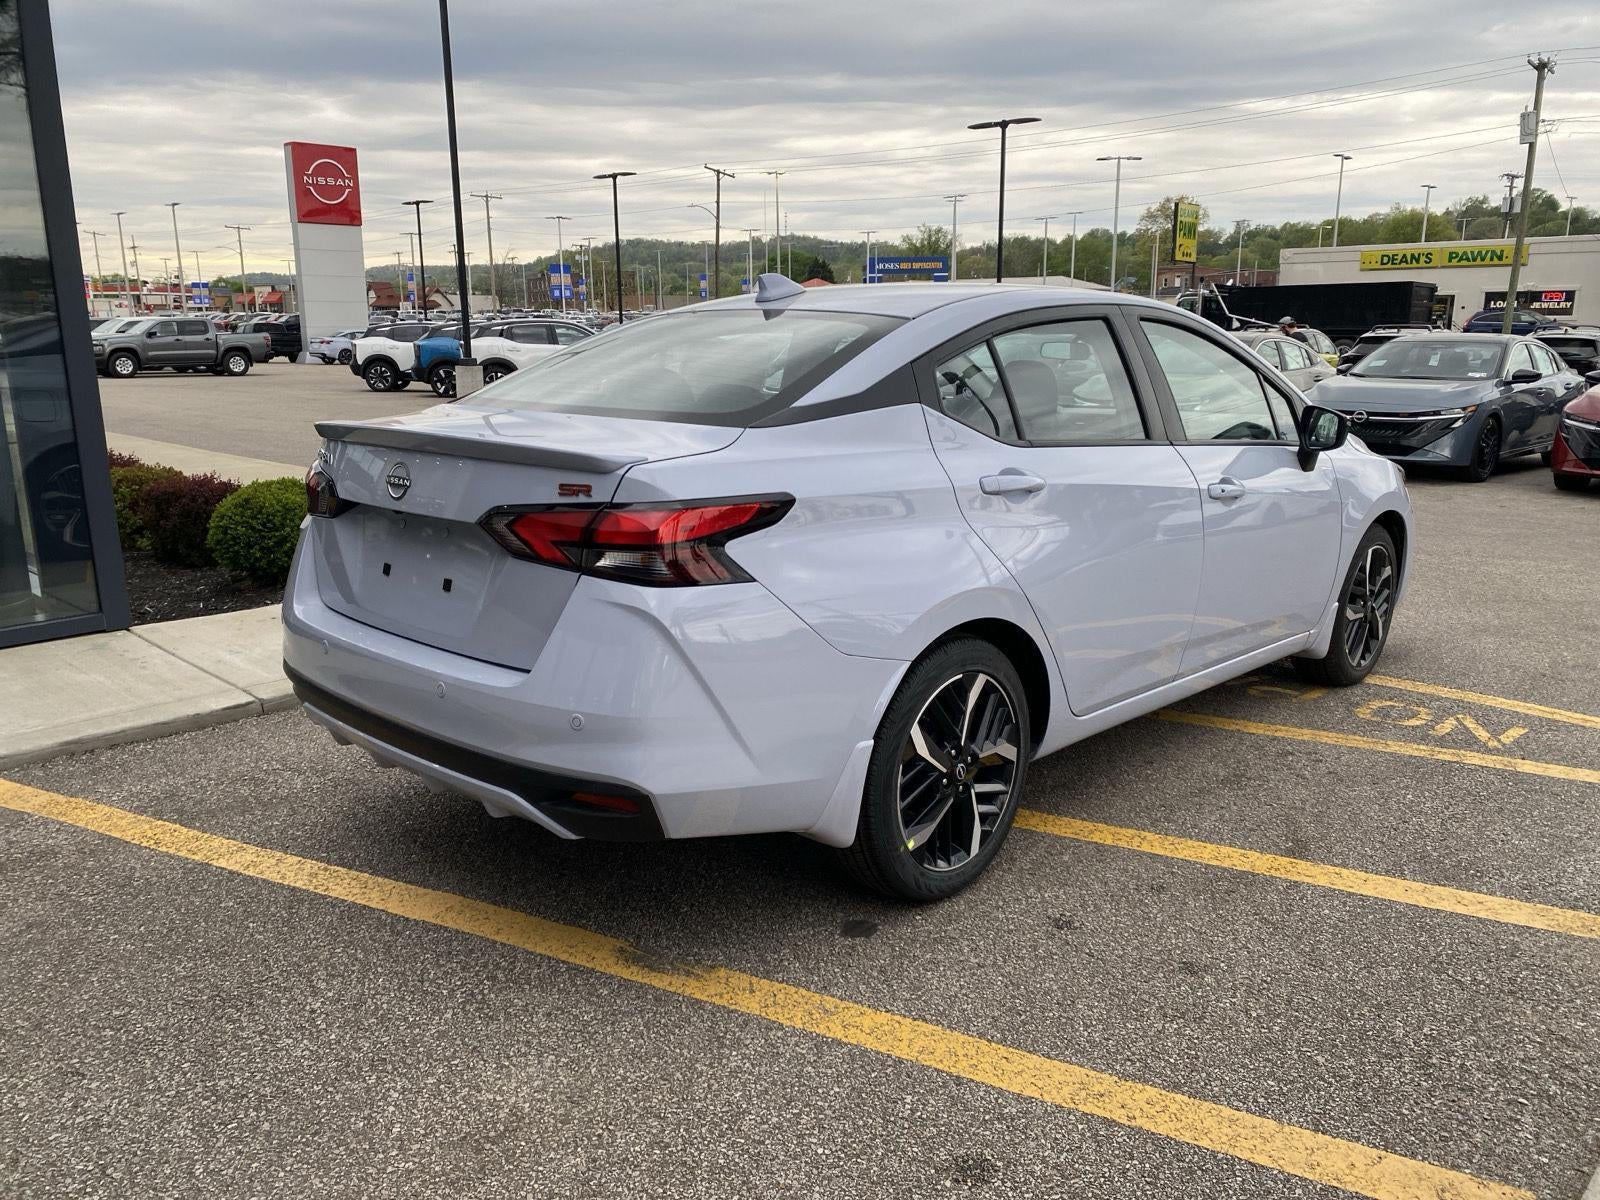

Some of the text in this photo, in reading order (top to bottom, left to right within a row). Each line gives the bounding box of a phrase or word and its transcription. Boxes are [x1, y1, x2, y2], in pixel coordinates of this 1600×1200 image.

[303, 176, 353, 187] NISSAN
[1178, 220, 1197, 240] PAWN
[875, 262, 900, 270] MOSES
[1542, 291, 1566, 301] OPEN
[386, 476, 410, 486] SSAN
[558, 483, 592, 497] SR
